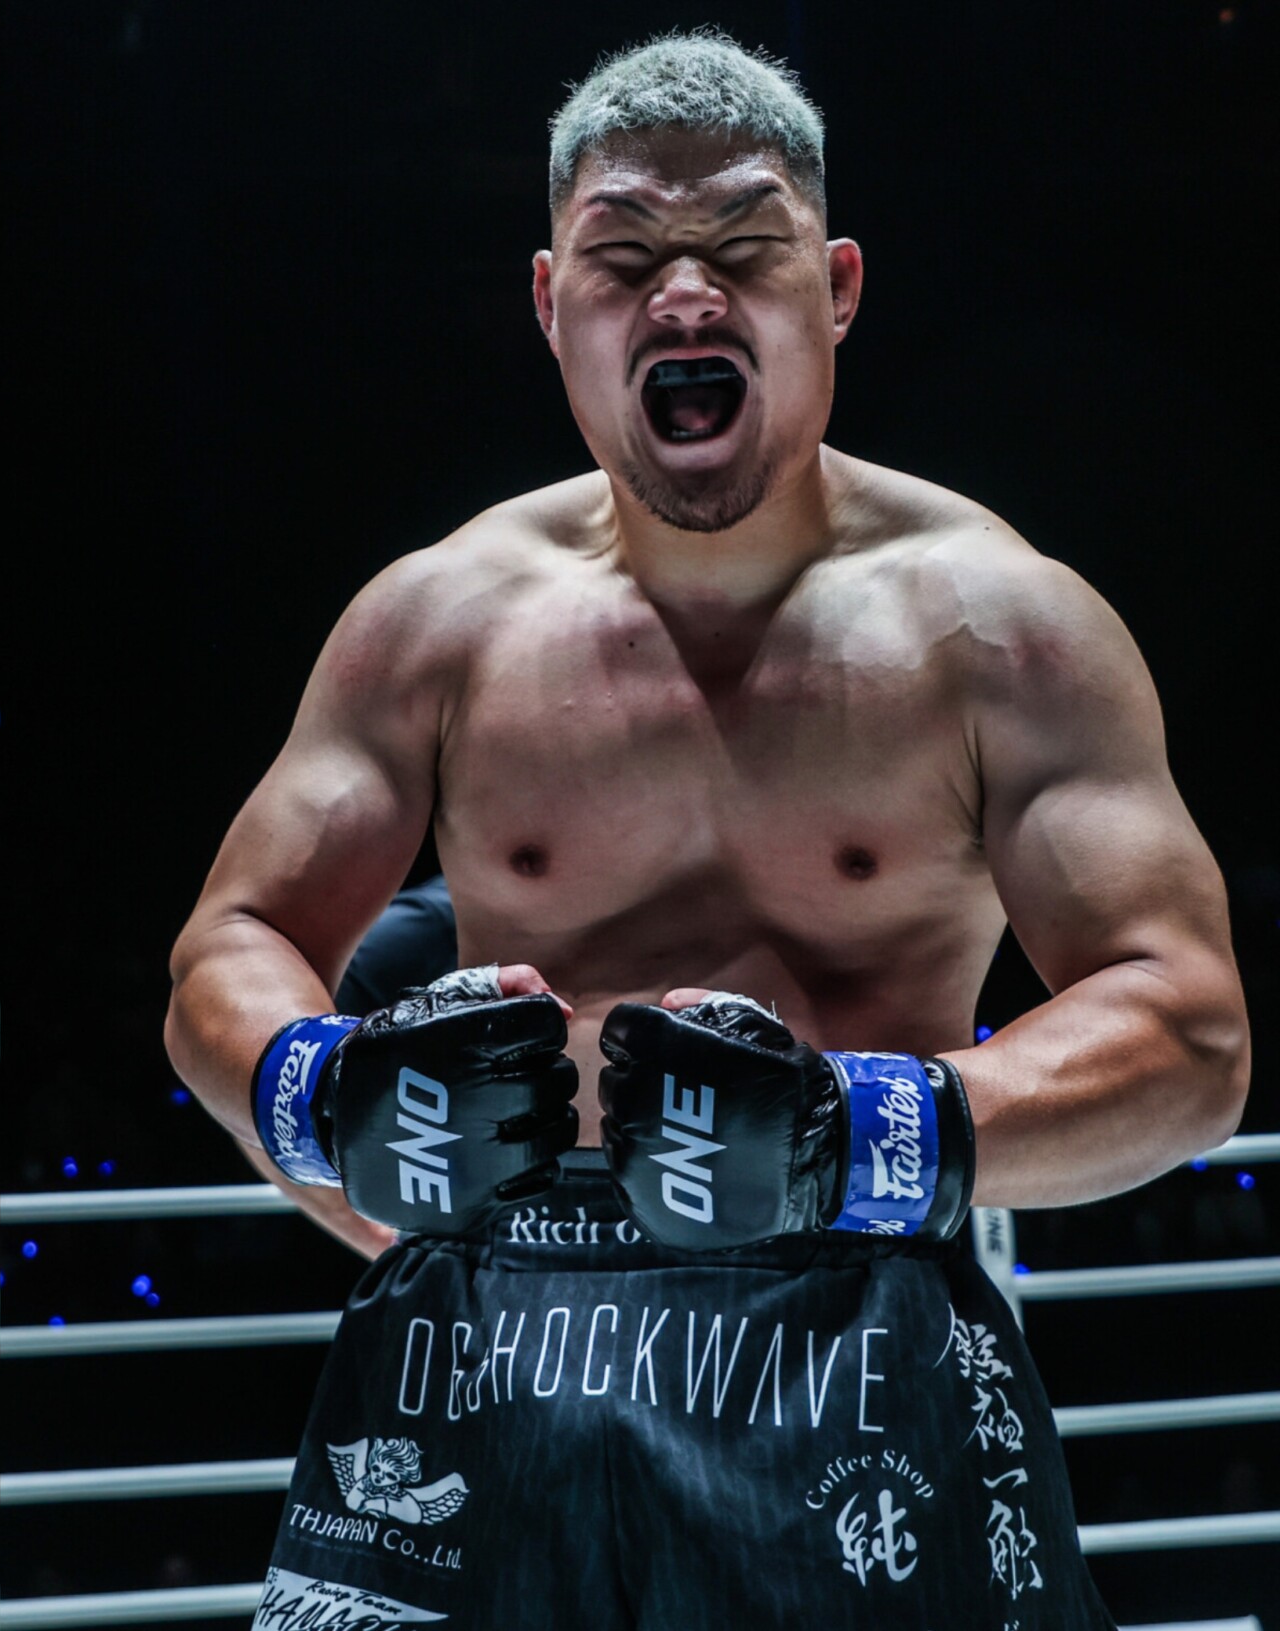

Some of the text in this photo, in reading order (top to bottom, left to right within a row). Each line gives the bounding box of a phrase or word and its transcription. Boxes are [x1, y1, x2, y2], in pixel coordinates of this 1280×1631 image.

[273, 1039, 322, 1159] Fairtex
[384, 1066, 464, 1214] ONE
[868, 1077, 924, 1200] Fairtex
[648, 1073, 728, 1224] ONE
[506, 1206, 652, 1245] Rich o
[987, 1211, 1003, 1254] NE
[805, 1449, 934, 1509] Coffee Shop
[354, 1590, 403, 1616] Team
